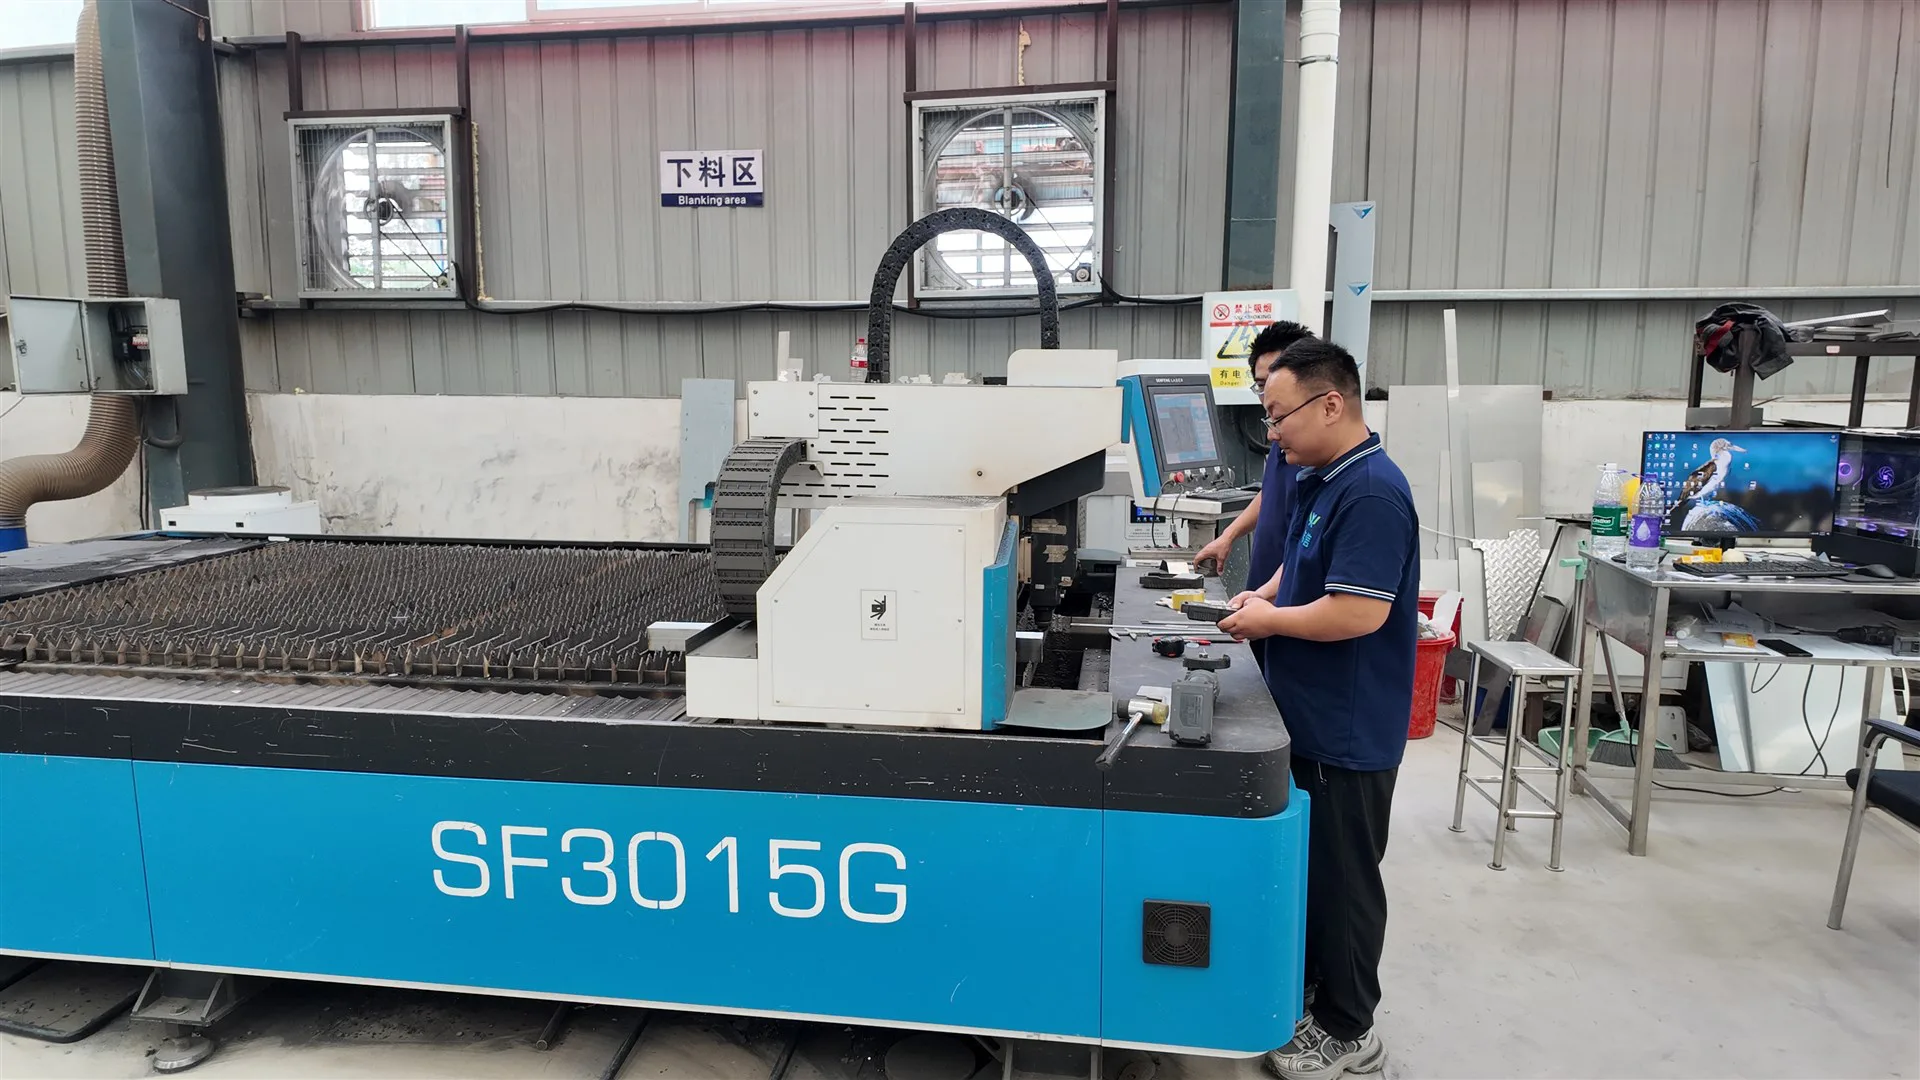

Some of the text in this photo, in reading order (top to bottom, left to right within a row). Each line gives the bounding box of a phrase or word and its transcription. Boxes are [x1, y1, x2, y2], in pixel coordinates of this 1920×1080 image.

[667, 156, 756, 187] 下料区
[678, 195, 747, 206] Blanking area
[1234, 303, 1272, 313] 禁止吸烟
[431, 820, 907, 924] SF3015G
